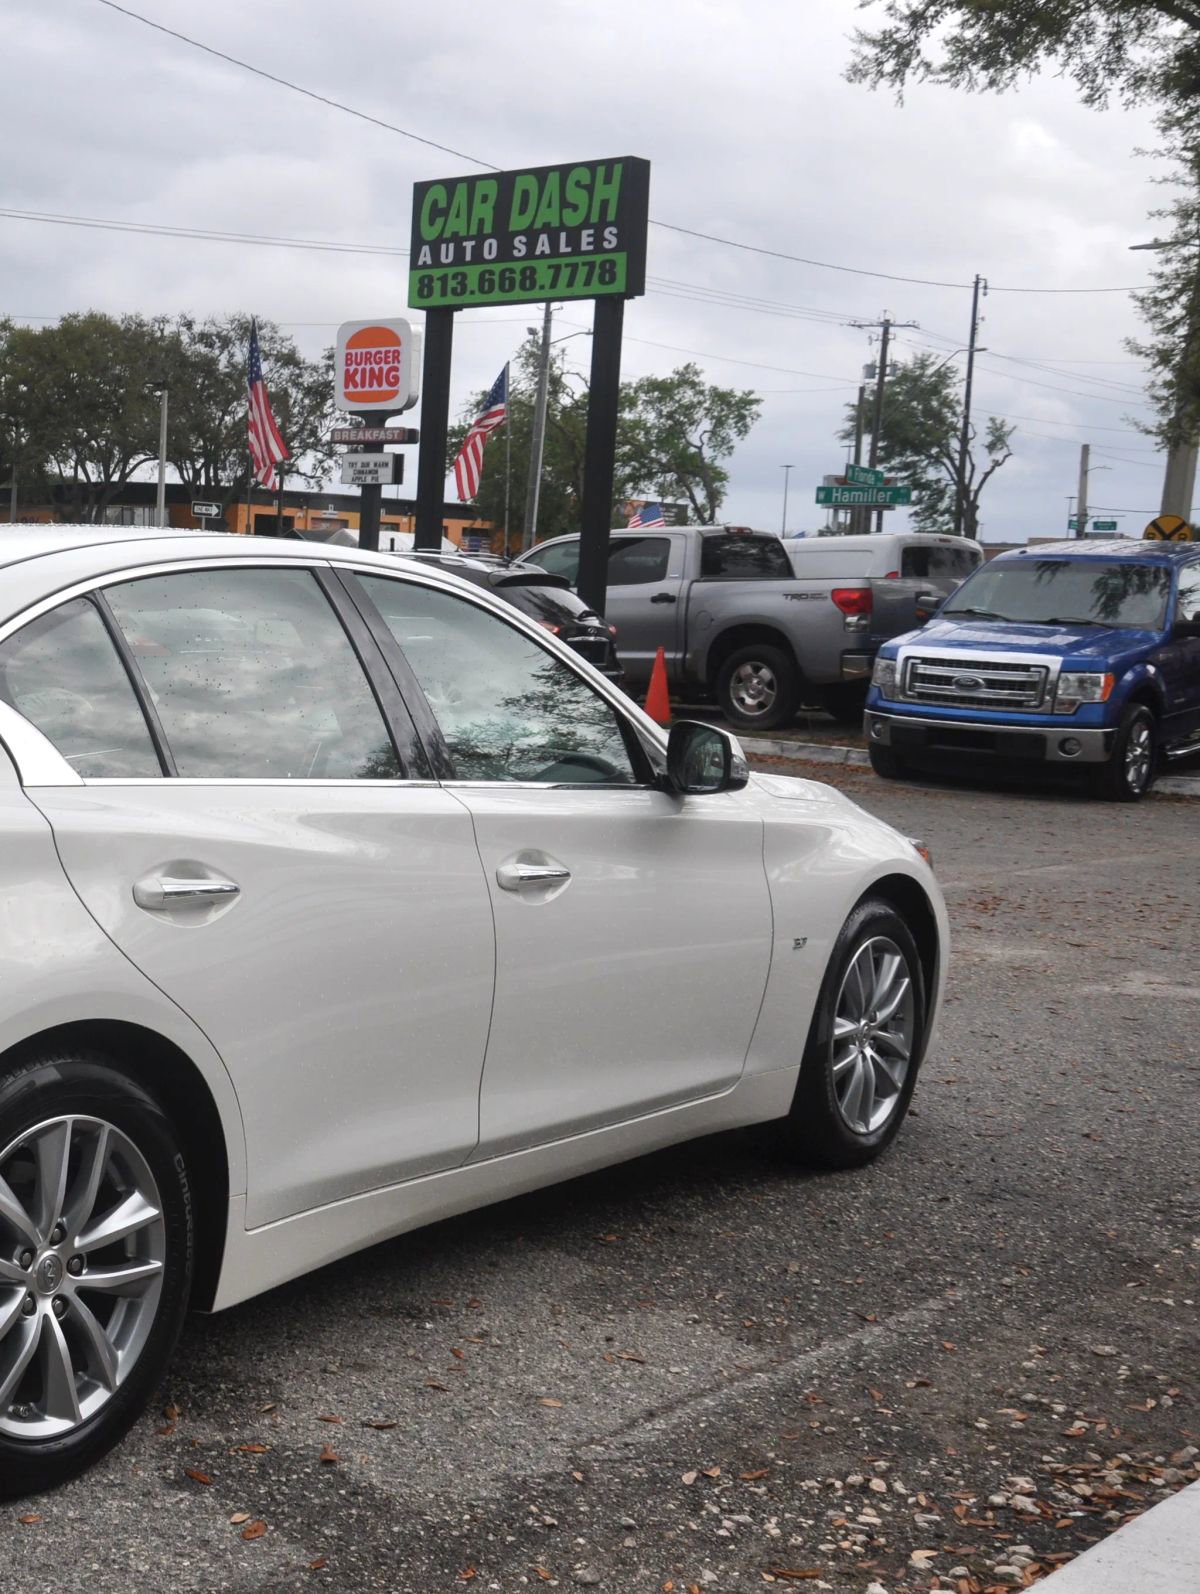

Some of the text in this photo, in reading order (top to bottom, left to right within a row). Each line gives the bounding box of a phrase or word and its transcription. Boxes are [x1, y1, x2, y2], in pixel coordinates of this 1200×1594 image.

[420, 163, 623, 241] CAR DASH
[417, 226, 619, 265] AUTO SALES
[417, 258, 617, 299] 813.668.7778
[345, 349, 400, 367] BURGER
[344, 365, 400, 390] KING
[334, 430, 400, 440] BREAKFAST
[832, 488, 893, 502] Hamiller
